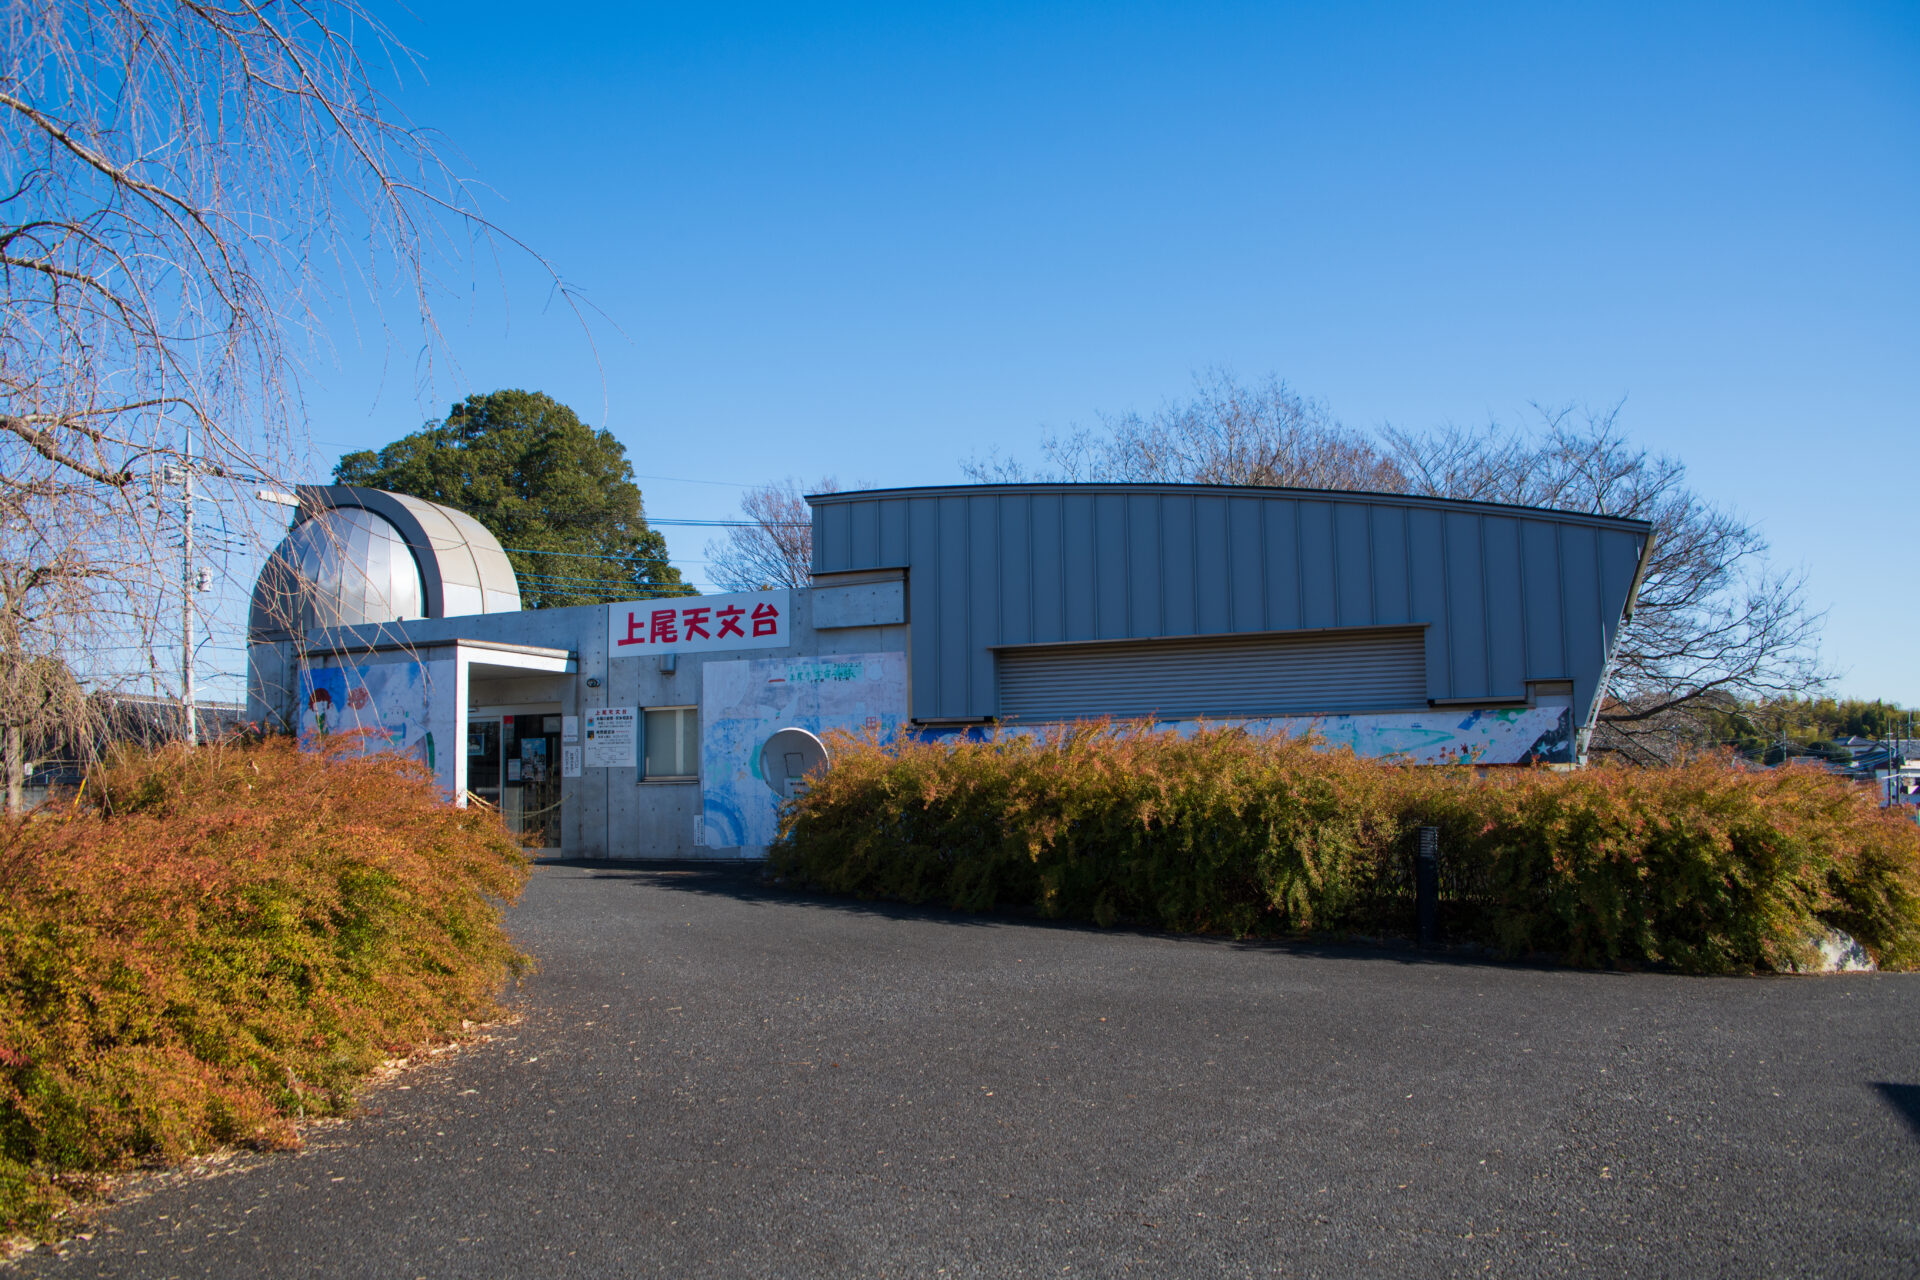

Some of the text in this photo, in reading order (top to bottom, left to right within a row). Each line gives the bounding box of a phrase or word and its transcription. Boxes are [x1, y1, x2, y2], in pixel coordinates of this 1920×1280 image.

[617, 602, 779, 646] 上尾天文台
